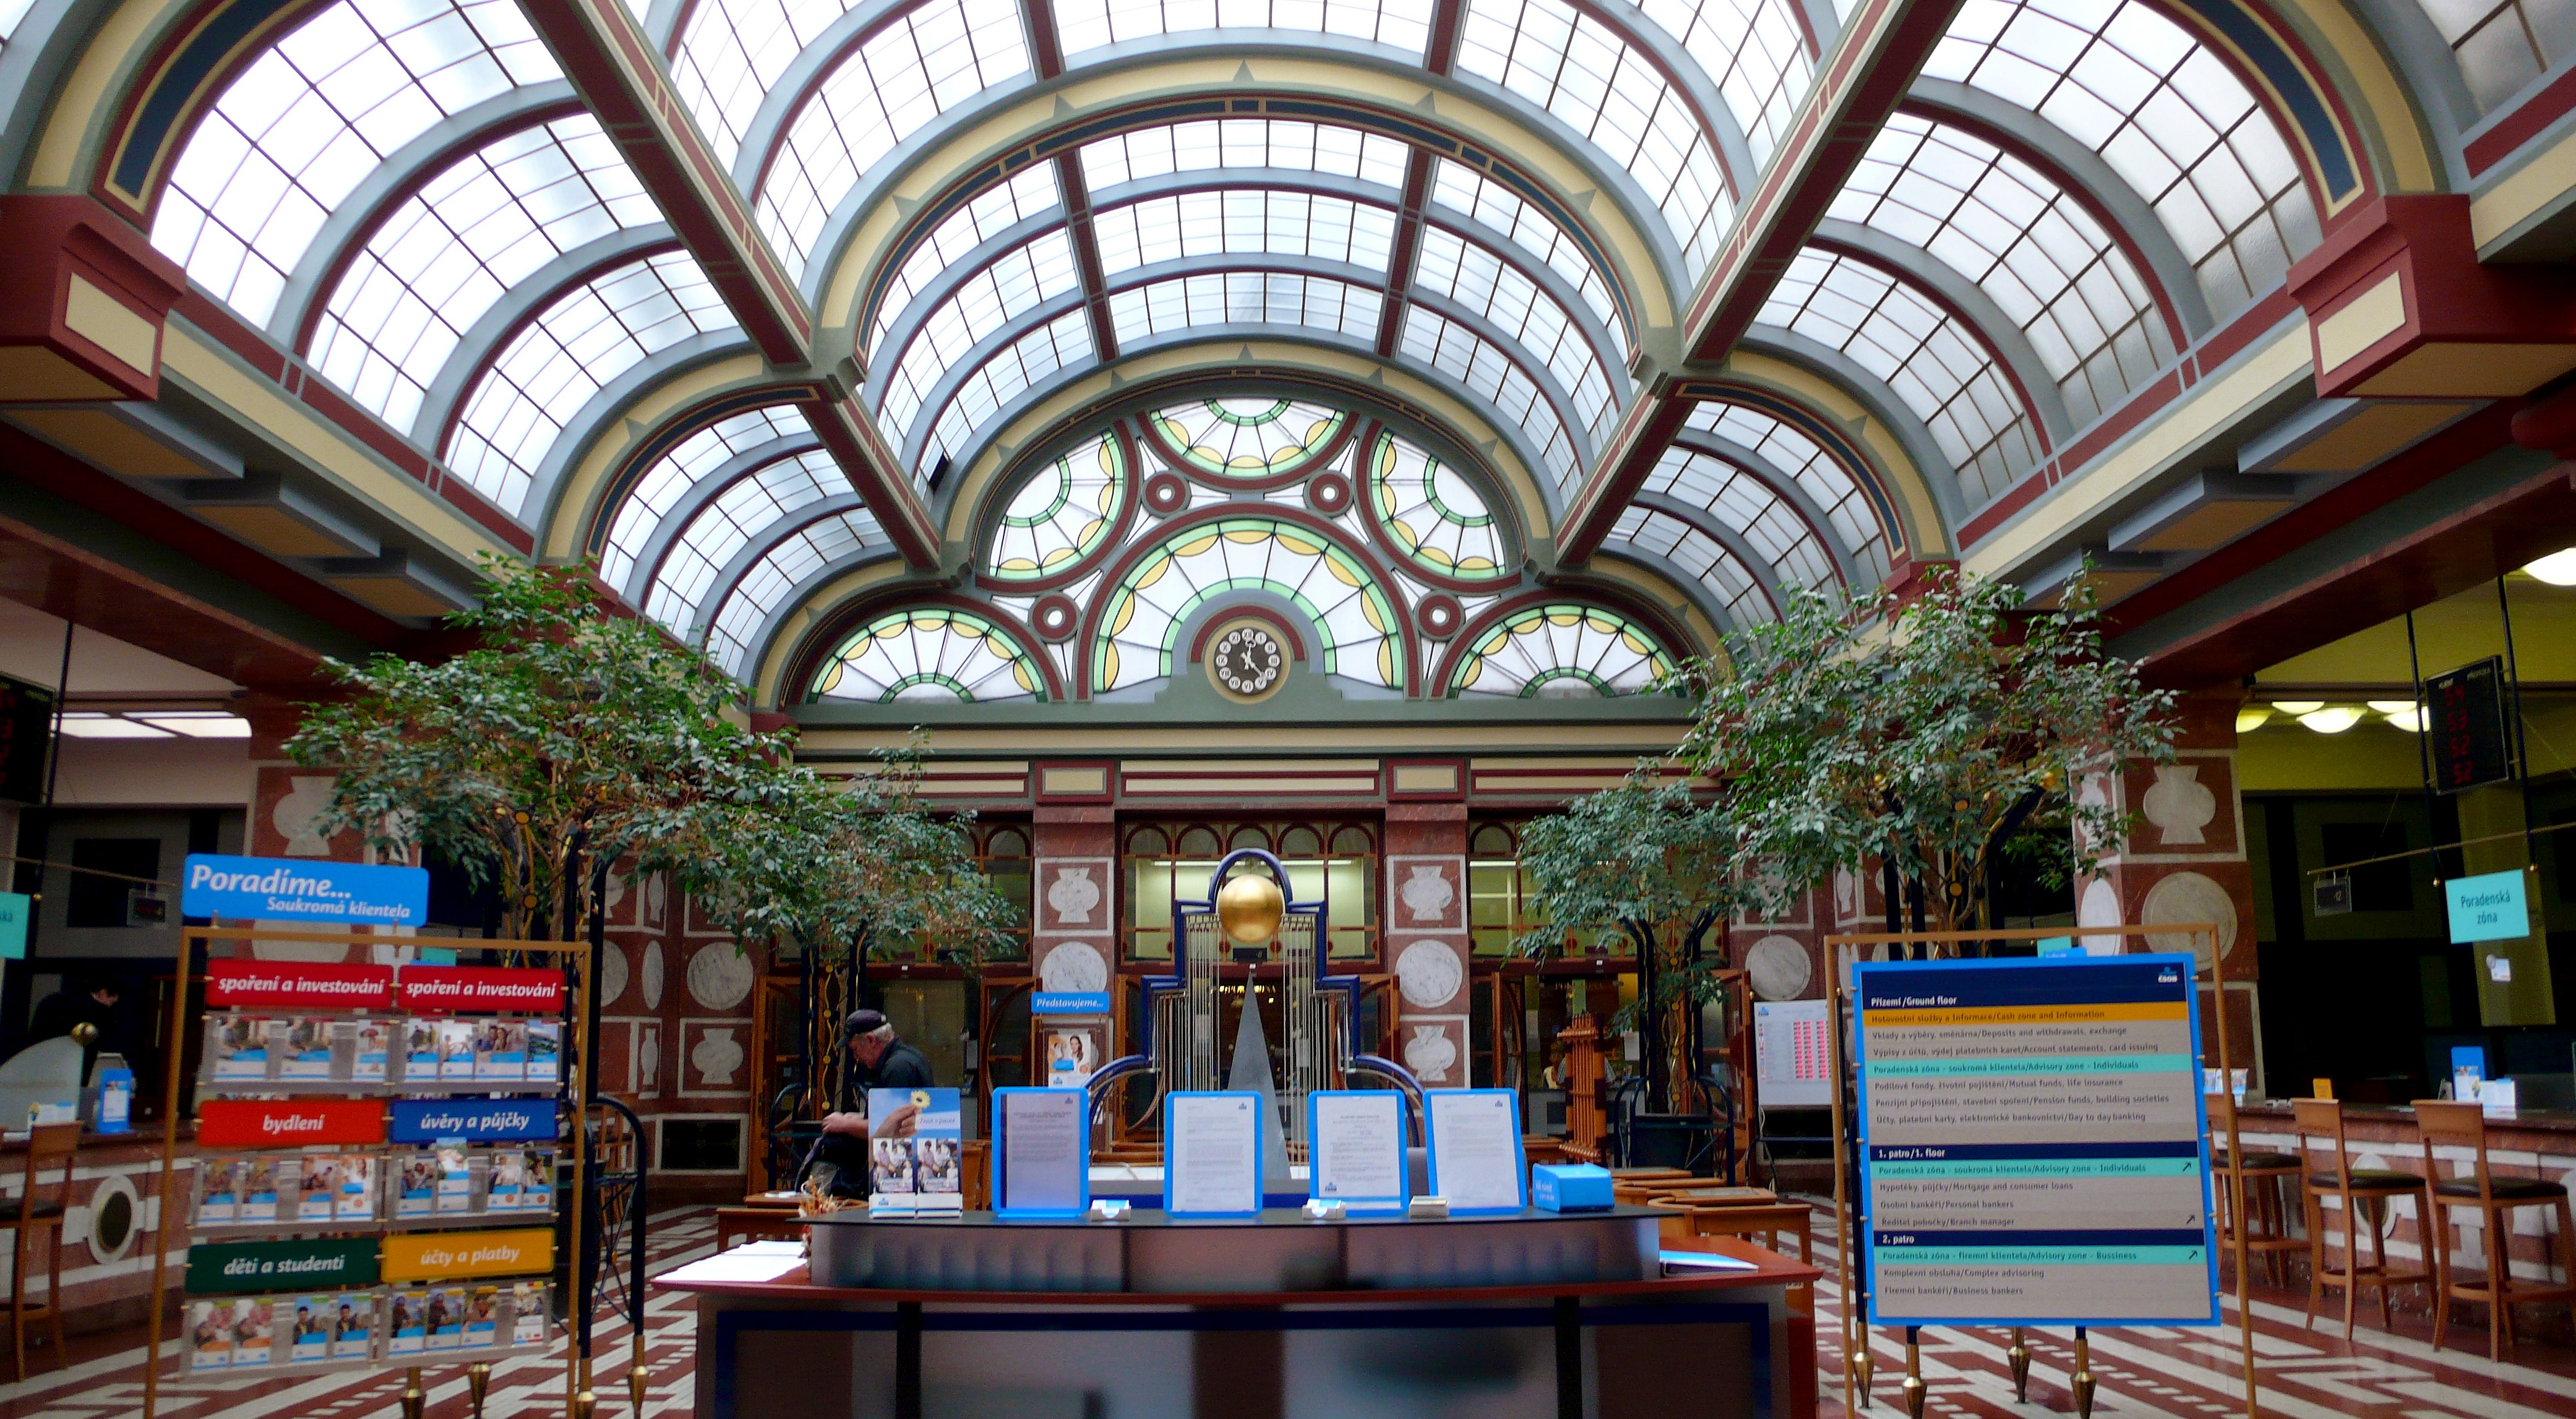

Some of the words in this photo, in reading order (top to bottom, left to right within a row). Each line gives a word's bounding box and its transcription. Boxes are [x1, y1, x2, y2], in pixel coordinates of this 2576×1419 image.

[191, 864, 351, 897] Poradíme...
[2461, 889, 2510, 908] Poradenská
[267, 896, 344, 914] Soukromá
[349, 901, 411, 918] klientela
[2477, 911, 2497, 924] zóna
[218, 976, 278, 993] spoření
[281, 980, 293, 991] a
[296, 977, 385, 994] investování
[406, 980, 460, 996] spoření
[463, 984, 474, 993] a
[476, 981, 556, 997] investování
[1937, 995, 1957, 1005] floor
[1871, 1014, 1914, 1023] Hotovostní
[1917, 1013, 1942, 1023] služby
[2038, 1010, 2053, 1019] and
[2056, 1009, 2105, 1018] Information
[1872, 1031, 1899, 1041] Vklady
[2019, 1027, 2033, 1035] and
[2089, 1025, 2127, 1036] exchange
[2108, 1042, 2126, 1051] card
[2129, 1042, 2158, 1052] issuing
[1874, 1065, 1918, 1073] Poradenská
[1921, 1065, 1939, 1073] zóna
[1948, 1063, 1987, 1072] soukromá
[2093, 1060, 2139, 1069] Individuals
[2039, 1078, 2064, 1088] funds,
[1875, 1099, 1907, 1108] Penzijní
[1962, 1097, 1996, 1105] stavební
[2067, 1095, 2093, 1105] funds,
[2096, 1094, 2130, 1105] building
[2132, 1094, 2169, 1102] societies
[262, 1114, 325, 1134] bydlení
[421, 1114, 463, 1132] úvěry
[466, 1117, 477, 1127] a
[480, 1112, 530, 1131] půjčky
[1899, 1115, 1931, 1125] platební
[1960, 1113, 2009, 1122] elektronické
[2086, 1112, 2094, 1120] to
[1925, 1148, 1946, 1157] floor
[1878, 1166, 1923, 1174] Poradenská
[1926, 1165, 1945, 1173] zóna
[1954, 1165, 1993, 1173] soukromá
[2100, 1163, 2146, 1172] Individuals
[2051, 1181, 2073, 1190] loans
[1981, 1199, 2013, 1207] bankers
[1980, 1219, 2014, 1227] manager
[1892, 1234, 1915, 1245] patro
[421, 1250, 452, 1267] účty
[457, 1252, 468, 1263] a
[471, 1245, 520, 1265] platby
[1883, 1251, 1928, 1259] Poradenská
[1931, 1251, 1949, 1259] zóna
[1959, 1251, 1988, 1259] firemní
[223, 1258, 257, 1275] děti
[260, 1263, 274, 1274] a
[277, 1254, 346, 1272] studenti
[1884, 1268, 1926, 1279] Komplexní
[2001, 1268, 2044, 1278] advisoring
[1884, 1286, 1915, 1294] Firemní
[1991, 1286, 2023, 1294] bankers
